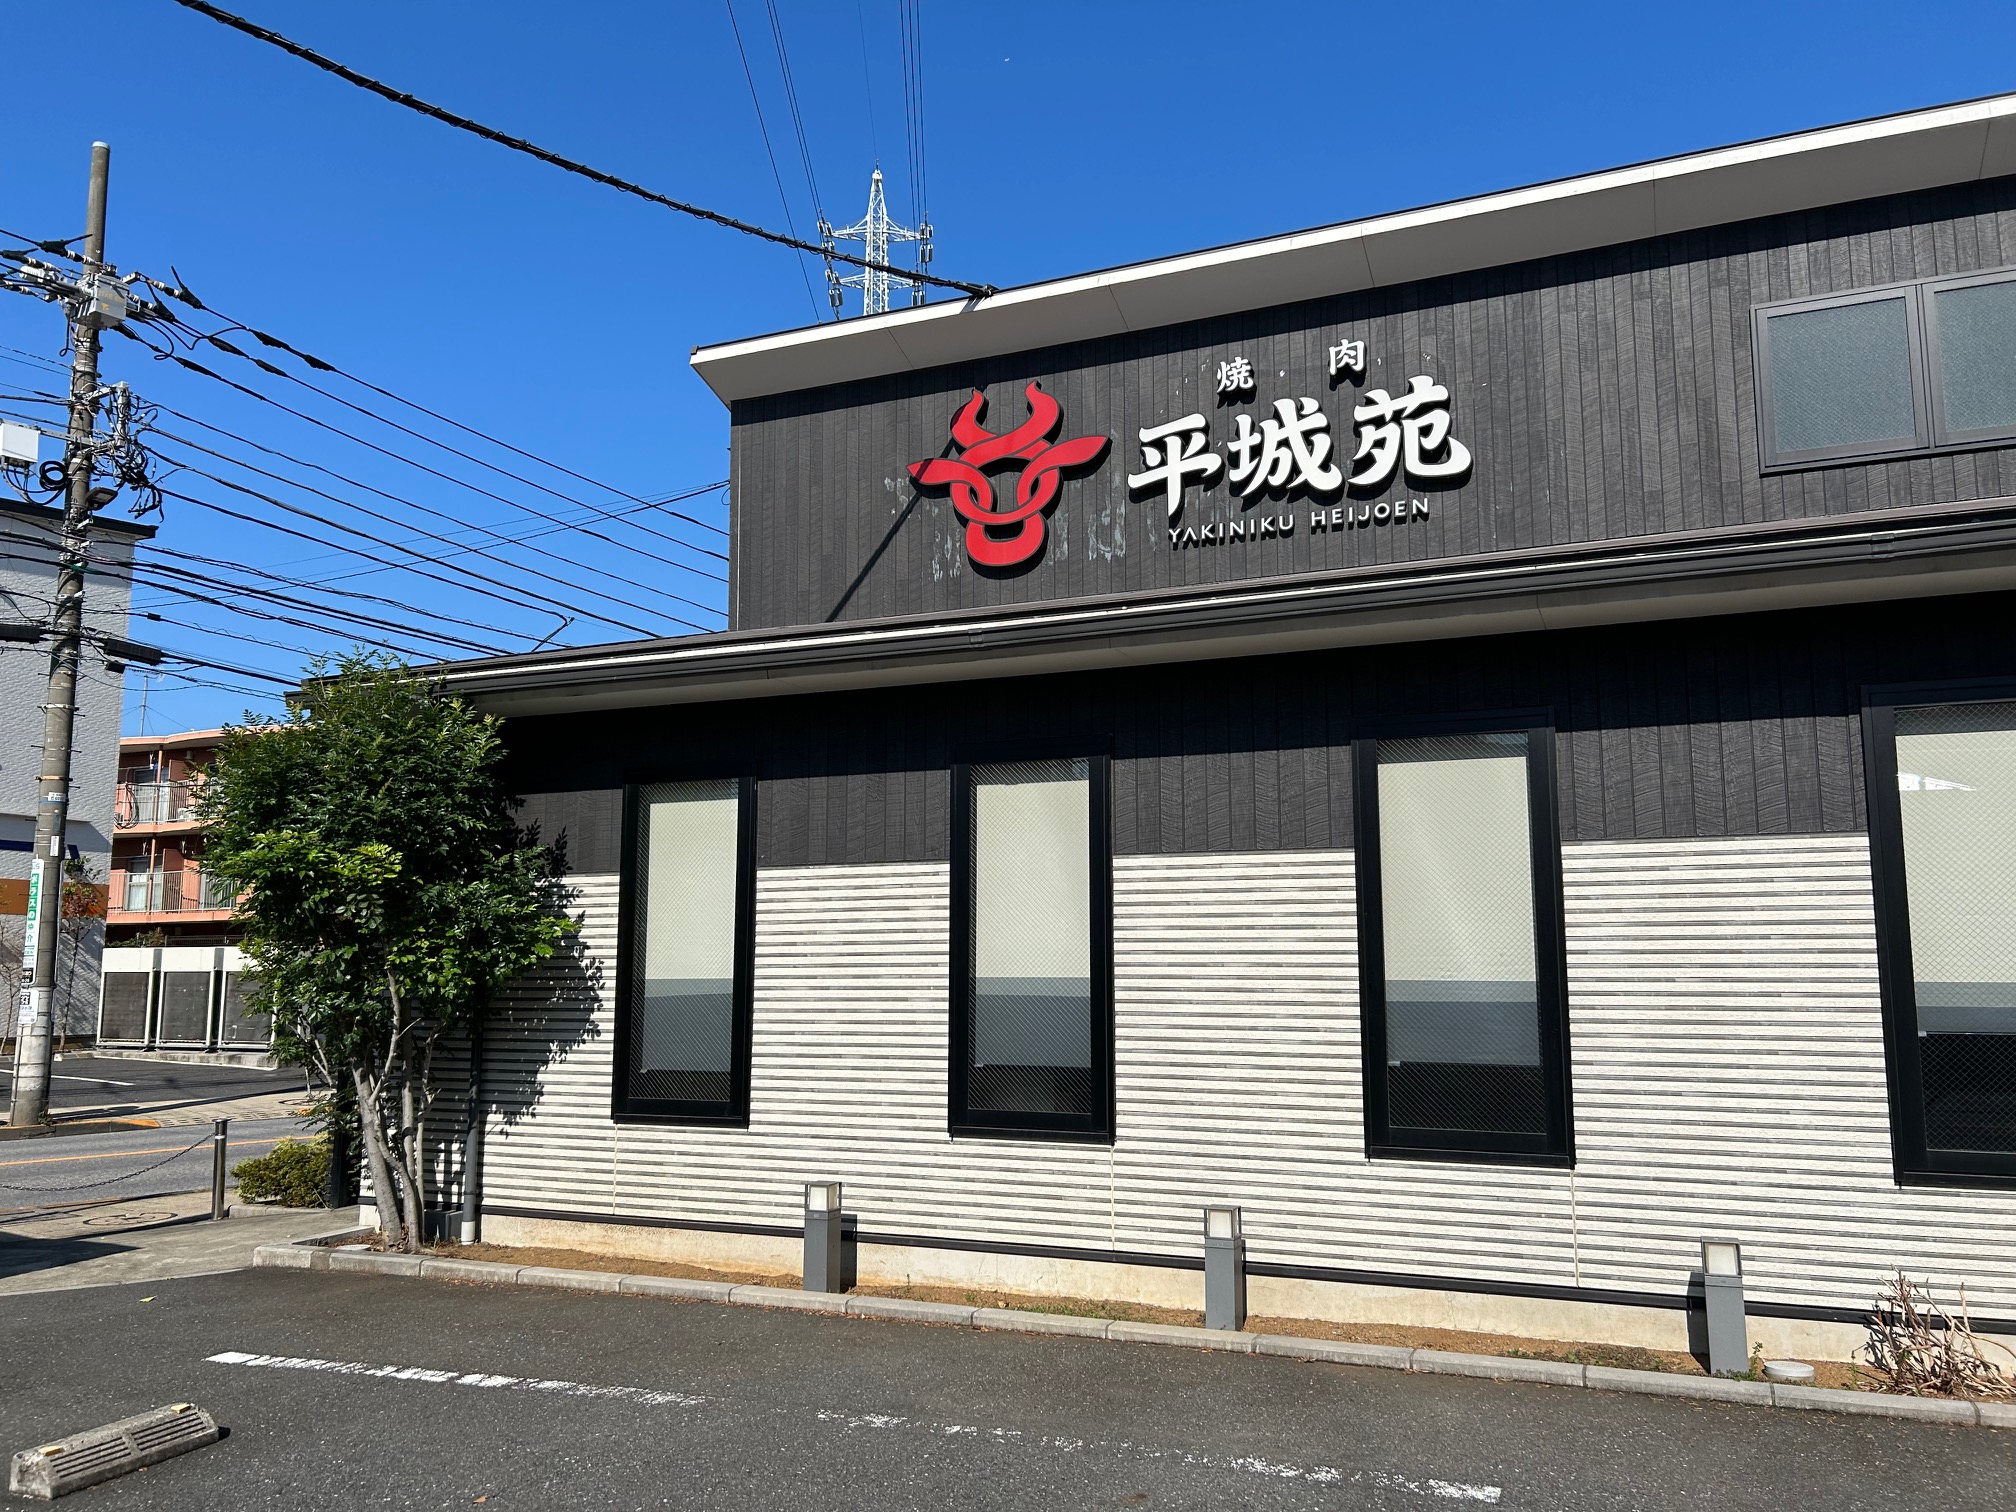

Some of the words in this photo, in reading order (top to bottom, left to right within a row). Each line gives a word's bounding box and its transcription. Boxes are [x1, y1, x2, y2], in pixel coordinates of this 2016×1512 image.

[1127, 375, 1472, 518] 平城苑
[1168, 514, 1295, 544] YAKINIKU
[1311, 497, 1429, 526] HEIJOEN
